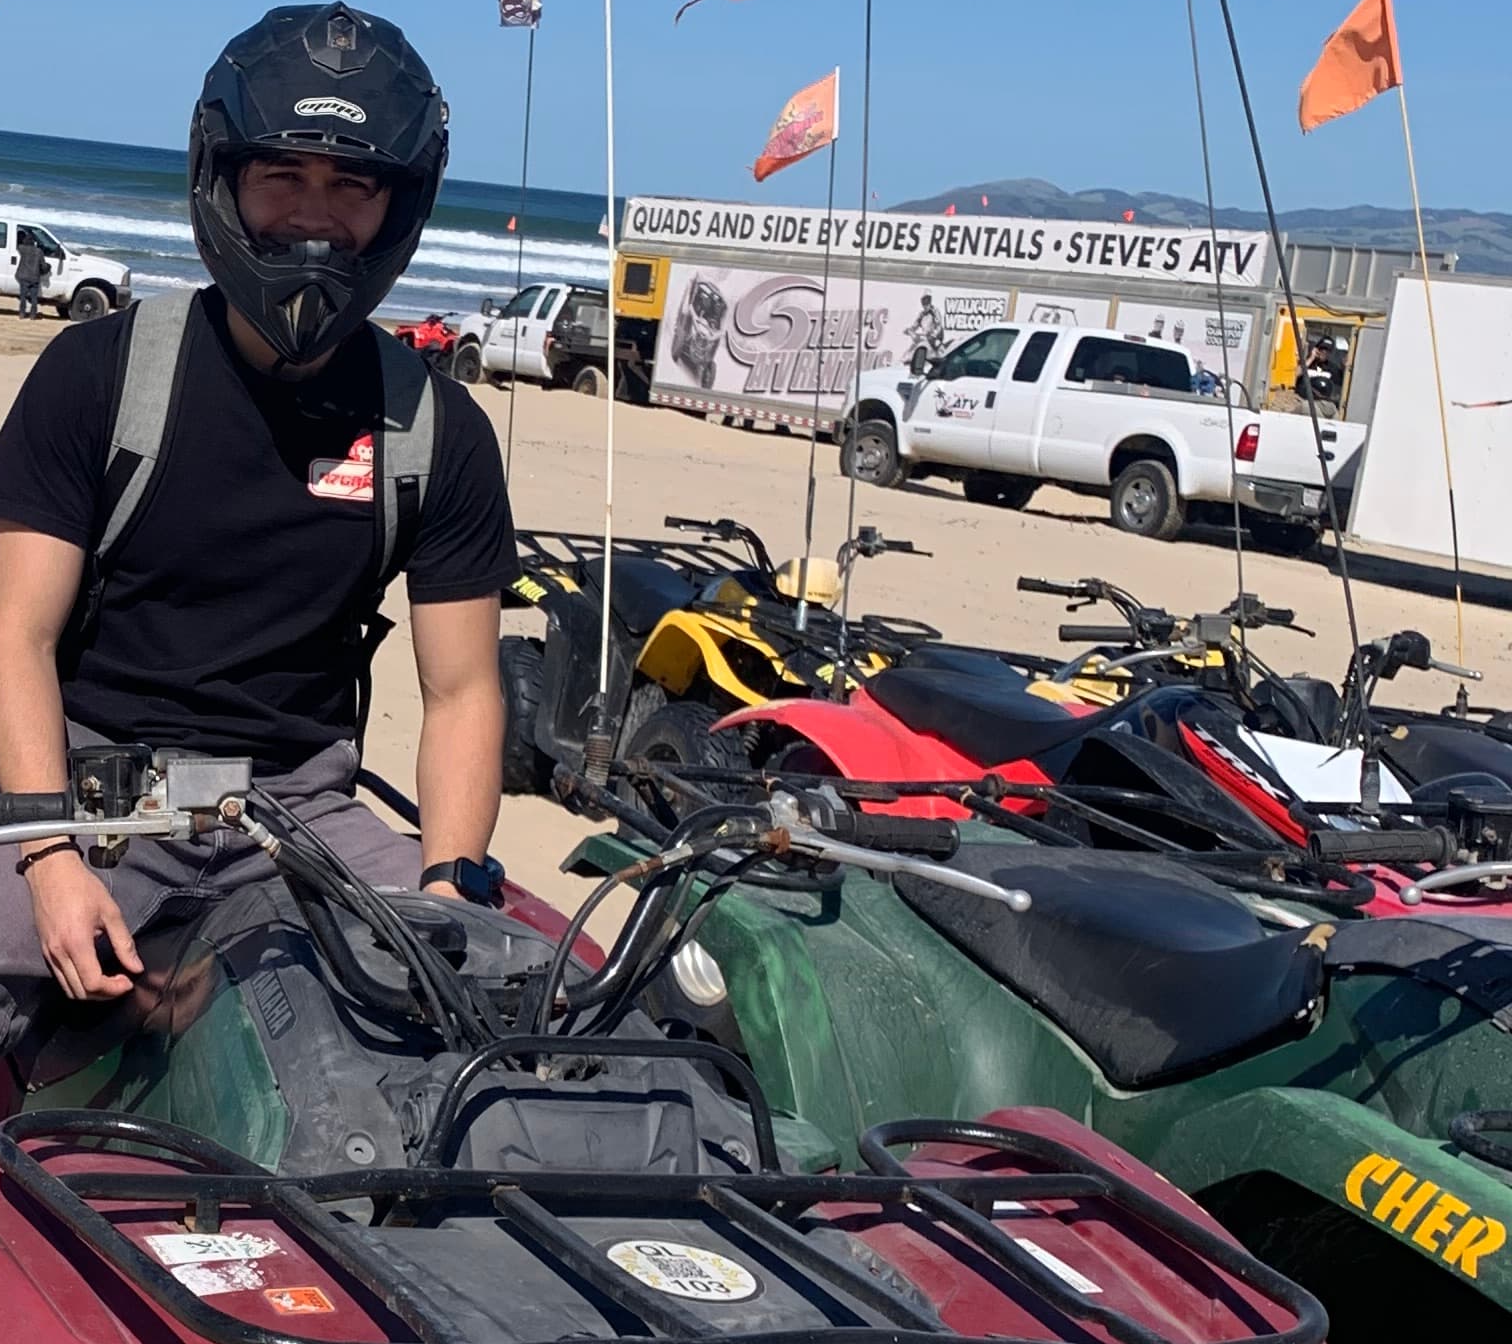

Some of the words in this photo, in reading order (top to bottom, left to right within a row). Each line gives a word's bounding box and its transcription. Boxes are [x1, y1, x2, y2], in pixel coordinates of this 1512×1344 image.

[633, 207, 701, 236] QUADS
[706, 212, 754, 239] AND
[761, 214, 809, 244] SIDE
[816, 217, 848, 247] BY
[852, 221, 922, 253] SIDES
[929, 224, 1044, 260] RENTALS
[1066, 231, 1182, 270] STEVE'S
[1189, 239, 1257, 275] ATV
[251, 967, 292, 1037] YAMAHA
[1345, 1153, 1507, 1279] CHER
[635, 1244, 688, 1258] QL
[671, 1279, 731, 1294] 103
